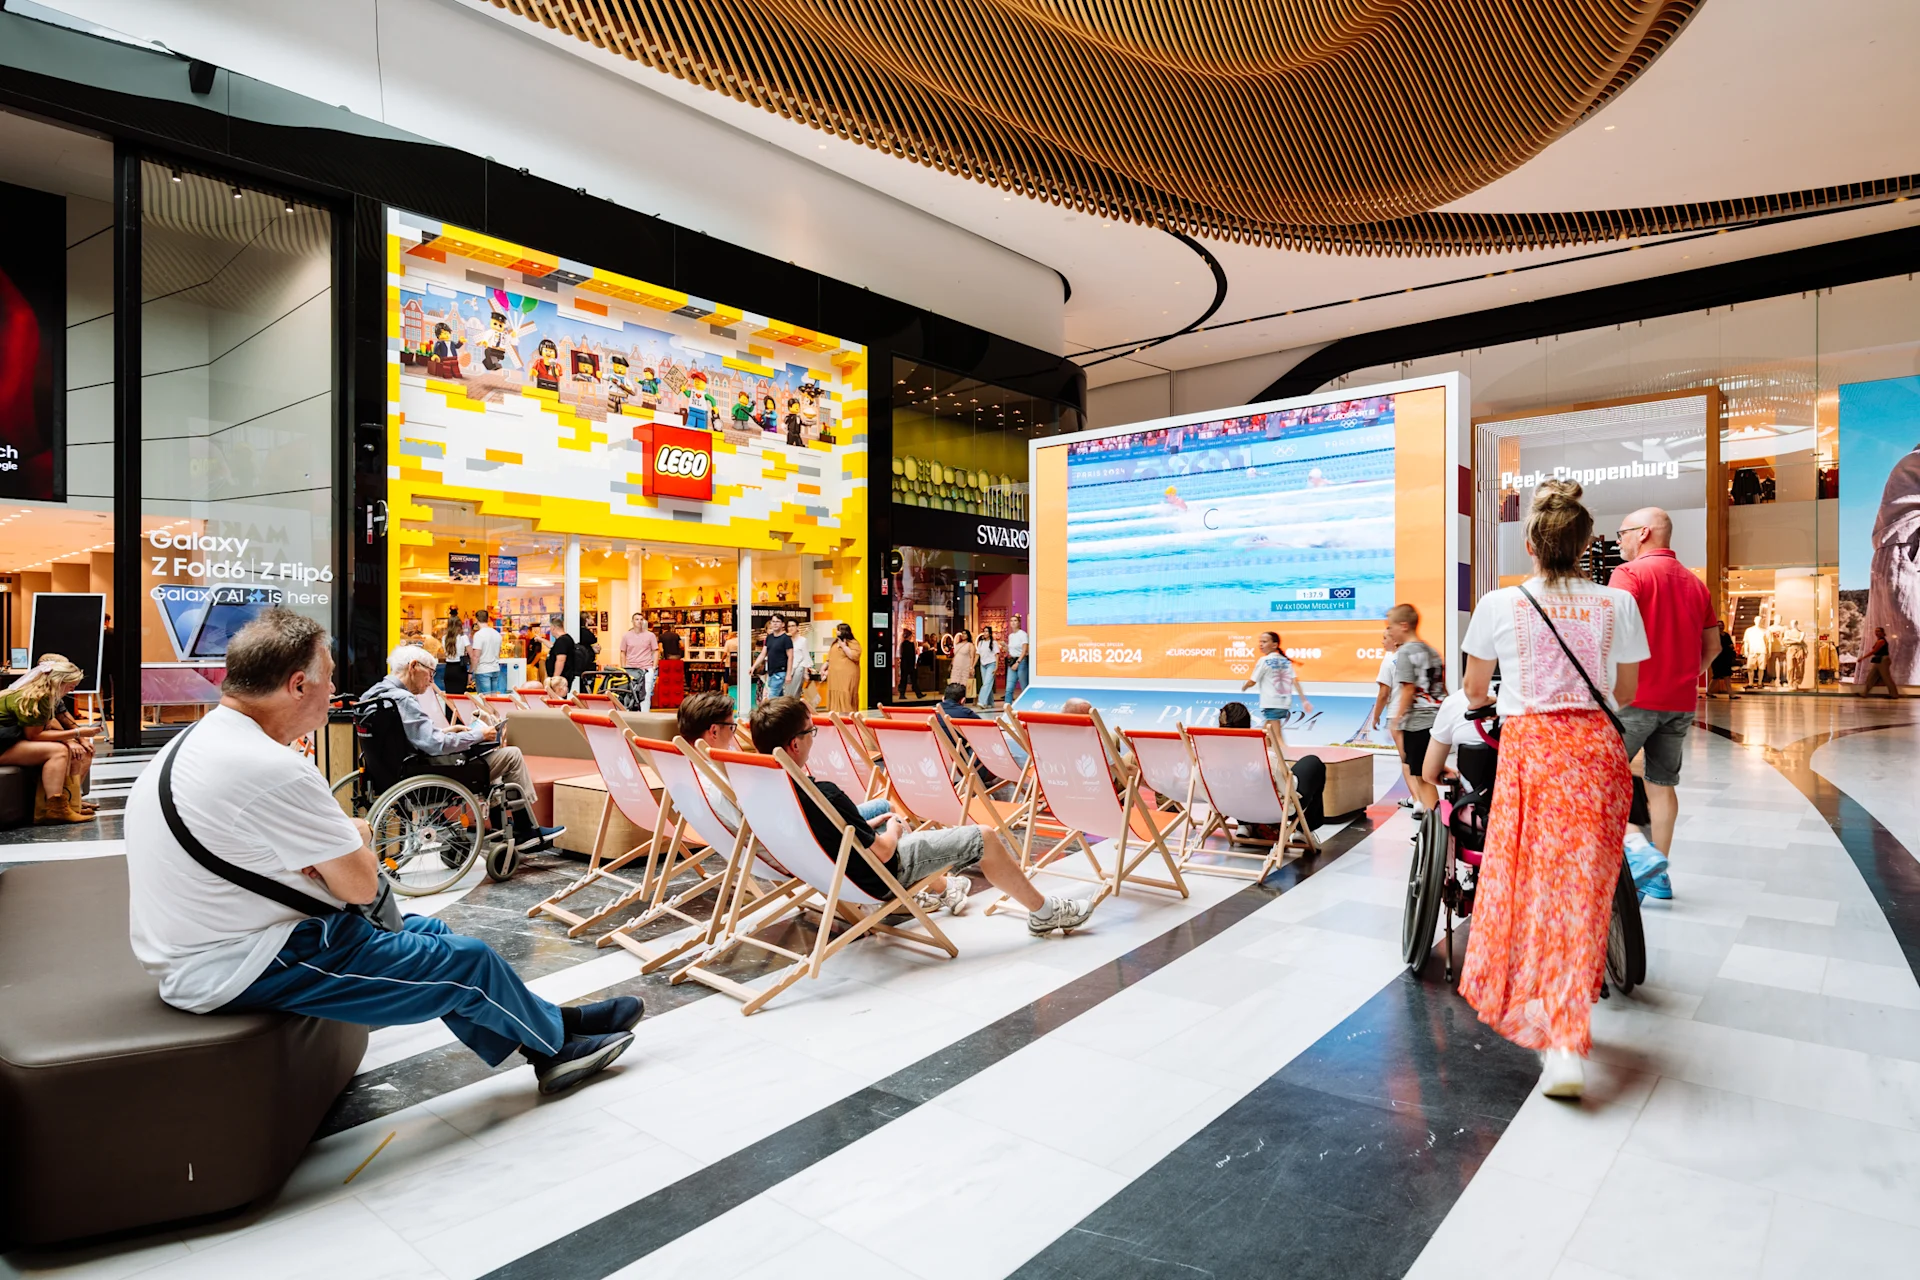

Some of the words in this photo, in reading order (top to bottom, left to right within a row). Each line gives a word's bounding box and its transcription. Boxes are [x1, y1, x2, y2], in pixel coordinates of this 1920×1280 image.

[1324, 409, 1368, 422] EUROSPORT
[0, 461, 18, 471] gle
[657, 447, 708, 477] LEGO
[1501, 470, 1546, 490] Peek
[1553, 460, 1679, 486] Cloppenburg
[150, 530, 249, 557] Galaxy
[977, 524, 1030, 549] SWARO
[152, 557, 167, 576] Z
[174, 558, 245, 579] Fold6
[260, 562, 274, 580] Z
[280, 562, 333, 587] Flip6
[150, 587, 223, 606] Galaxy
[227, 589, 244, 603] AI
[268, 589, 282, 603] is
[287, 591, 328, 605] here
[1303, 591, 1324, 599] 1:37.9
[1541, 605, 1591, 623] DREAM
[1061, 648, 1103, 663] PARIS
[1105, 648, 1143, 663] 2024
[1166, 648, 1217, 657] EUROSPORT
[1224, 647, 1255, 658] max
[1356, 647, 1385, 659] OCE
[1156, 704, 1263, 728] PARS
